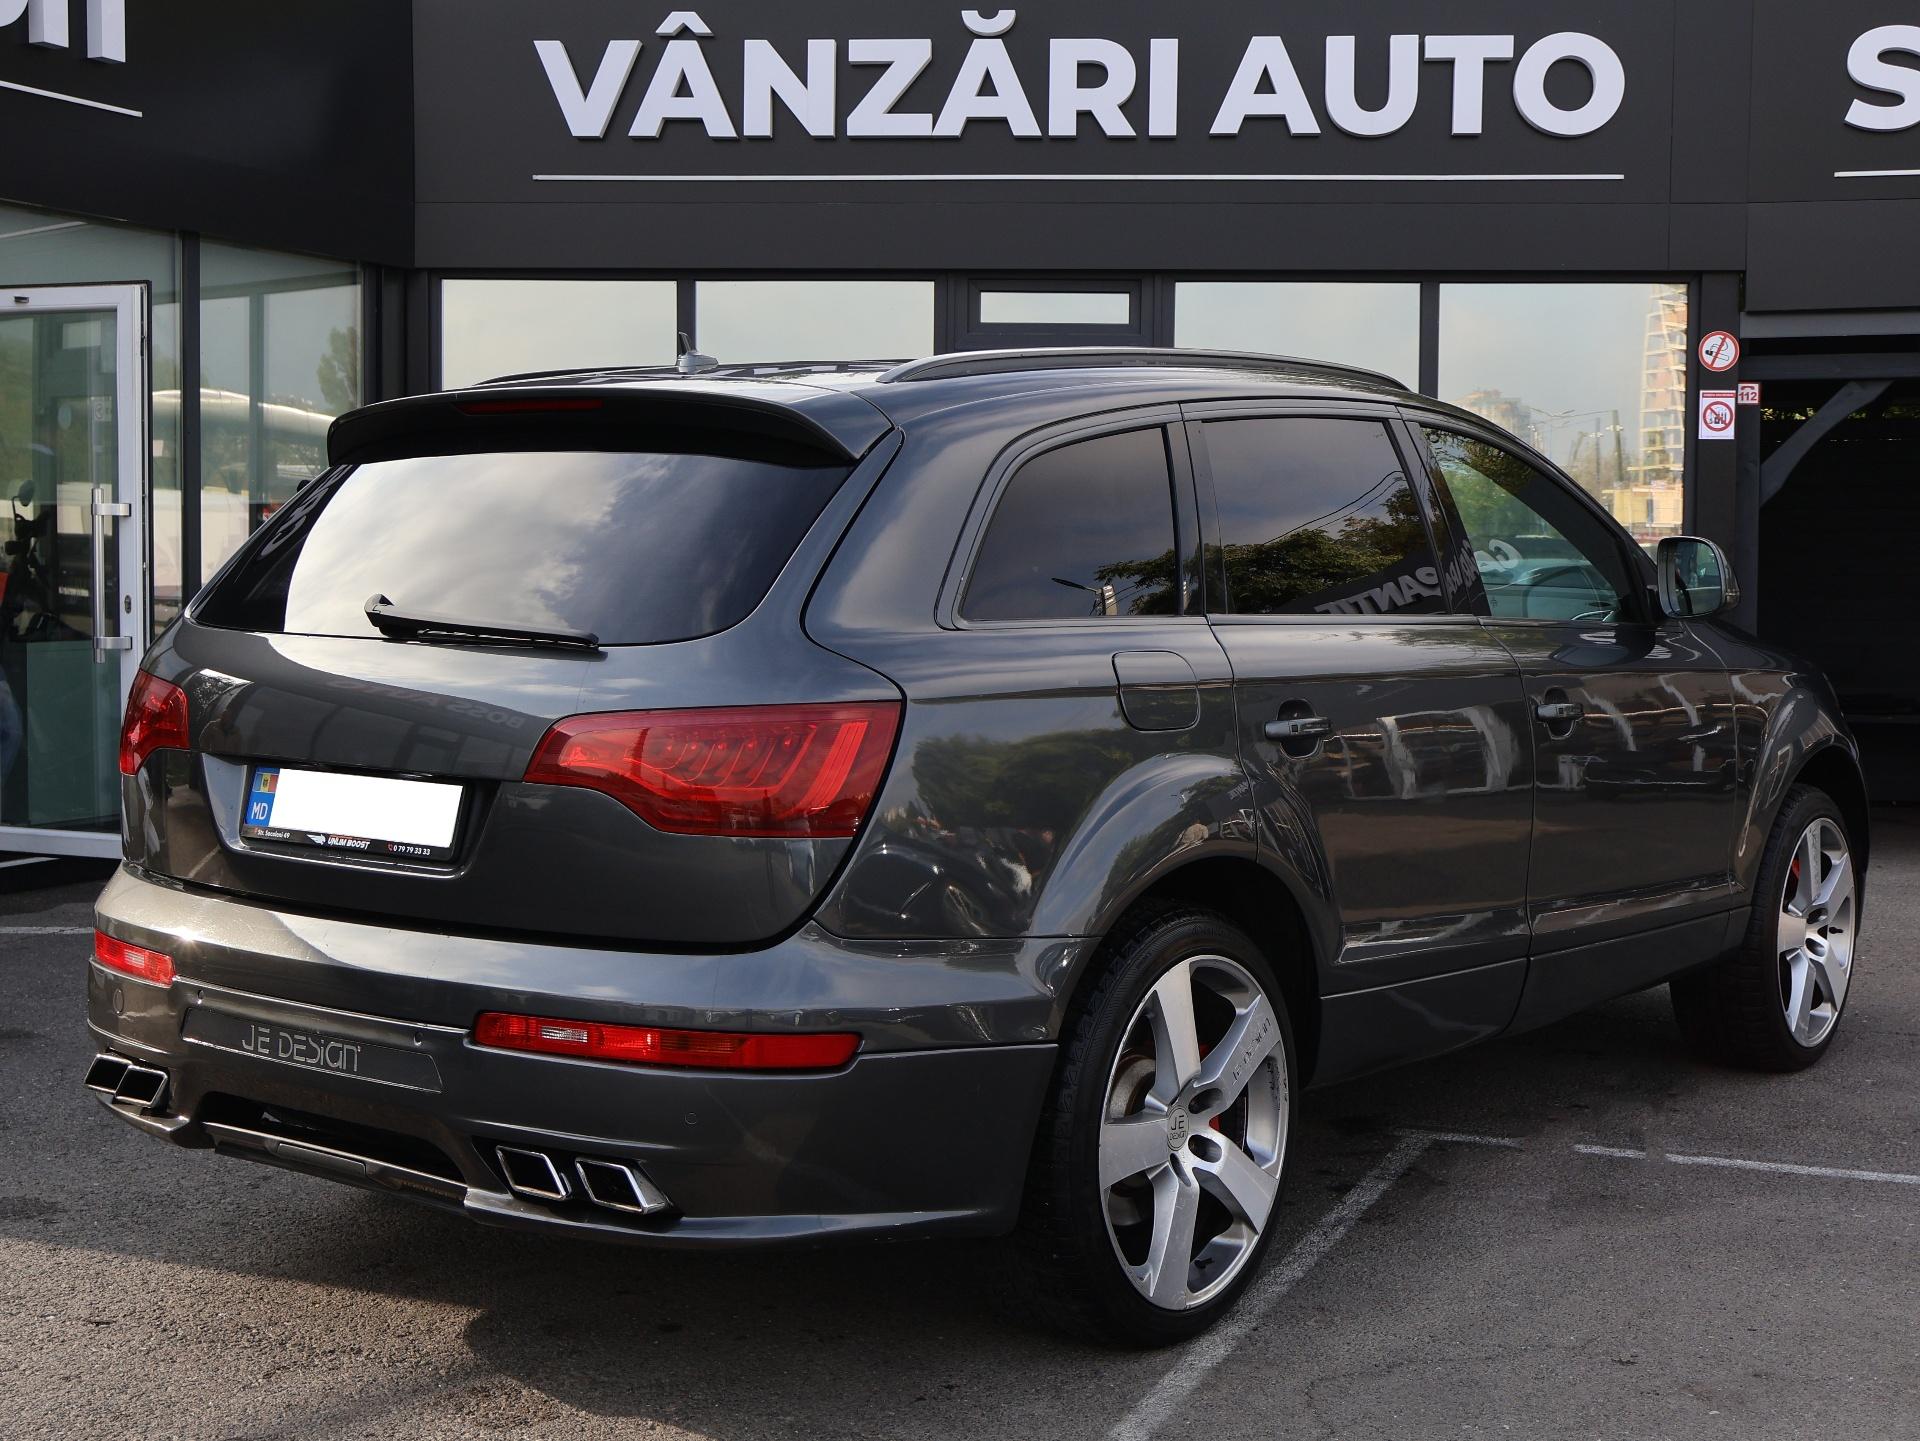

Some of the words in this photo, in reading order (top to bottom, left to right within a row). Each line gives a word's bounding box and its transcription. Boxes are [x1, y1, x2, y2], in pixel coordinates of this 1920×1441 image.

[533, 9, 1179, 139] VÂNZĂRI
[1208, 31, 1626, 138] AUTO
[1738, 391, 1758, 402] 112
[251, 801, 268, 820] MD
[346, 839, 370, 850] BOOST
[242, 1024, 271, 1055] JE
[1170, 1114, 1185, 1131] JE
